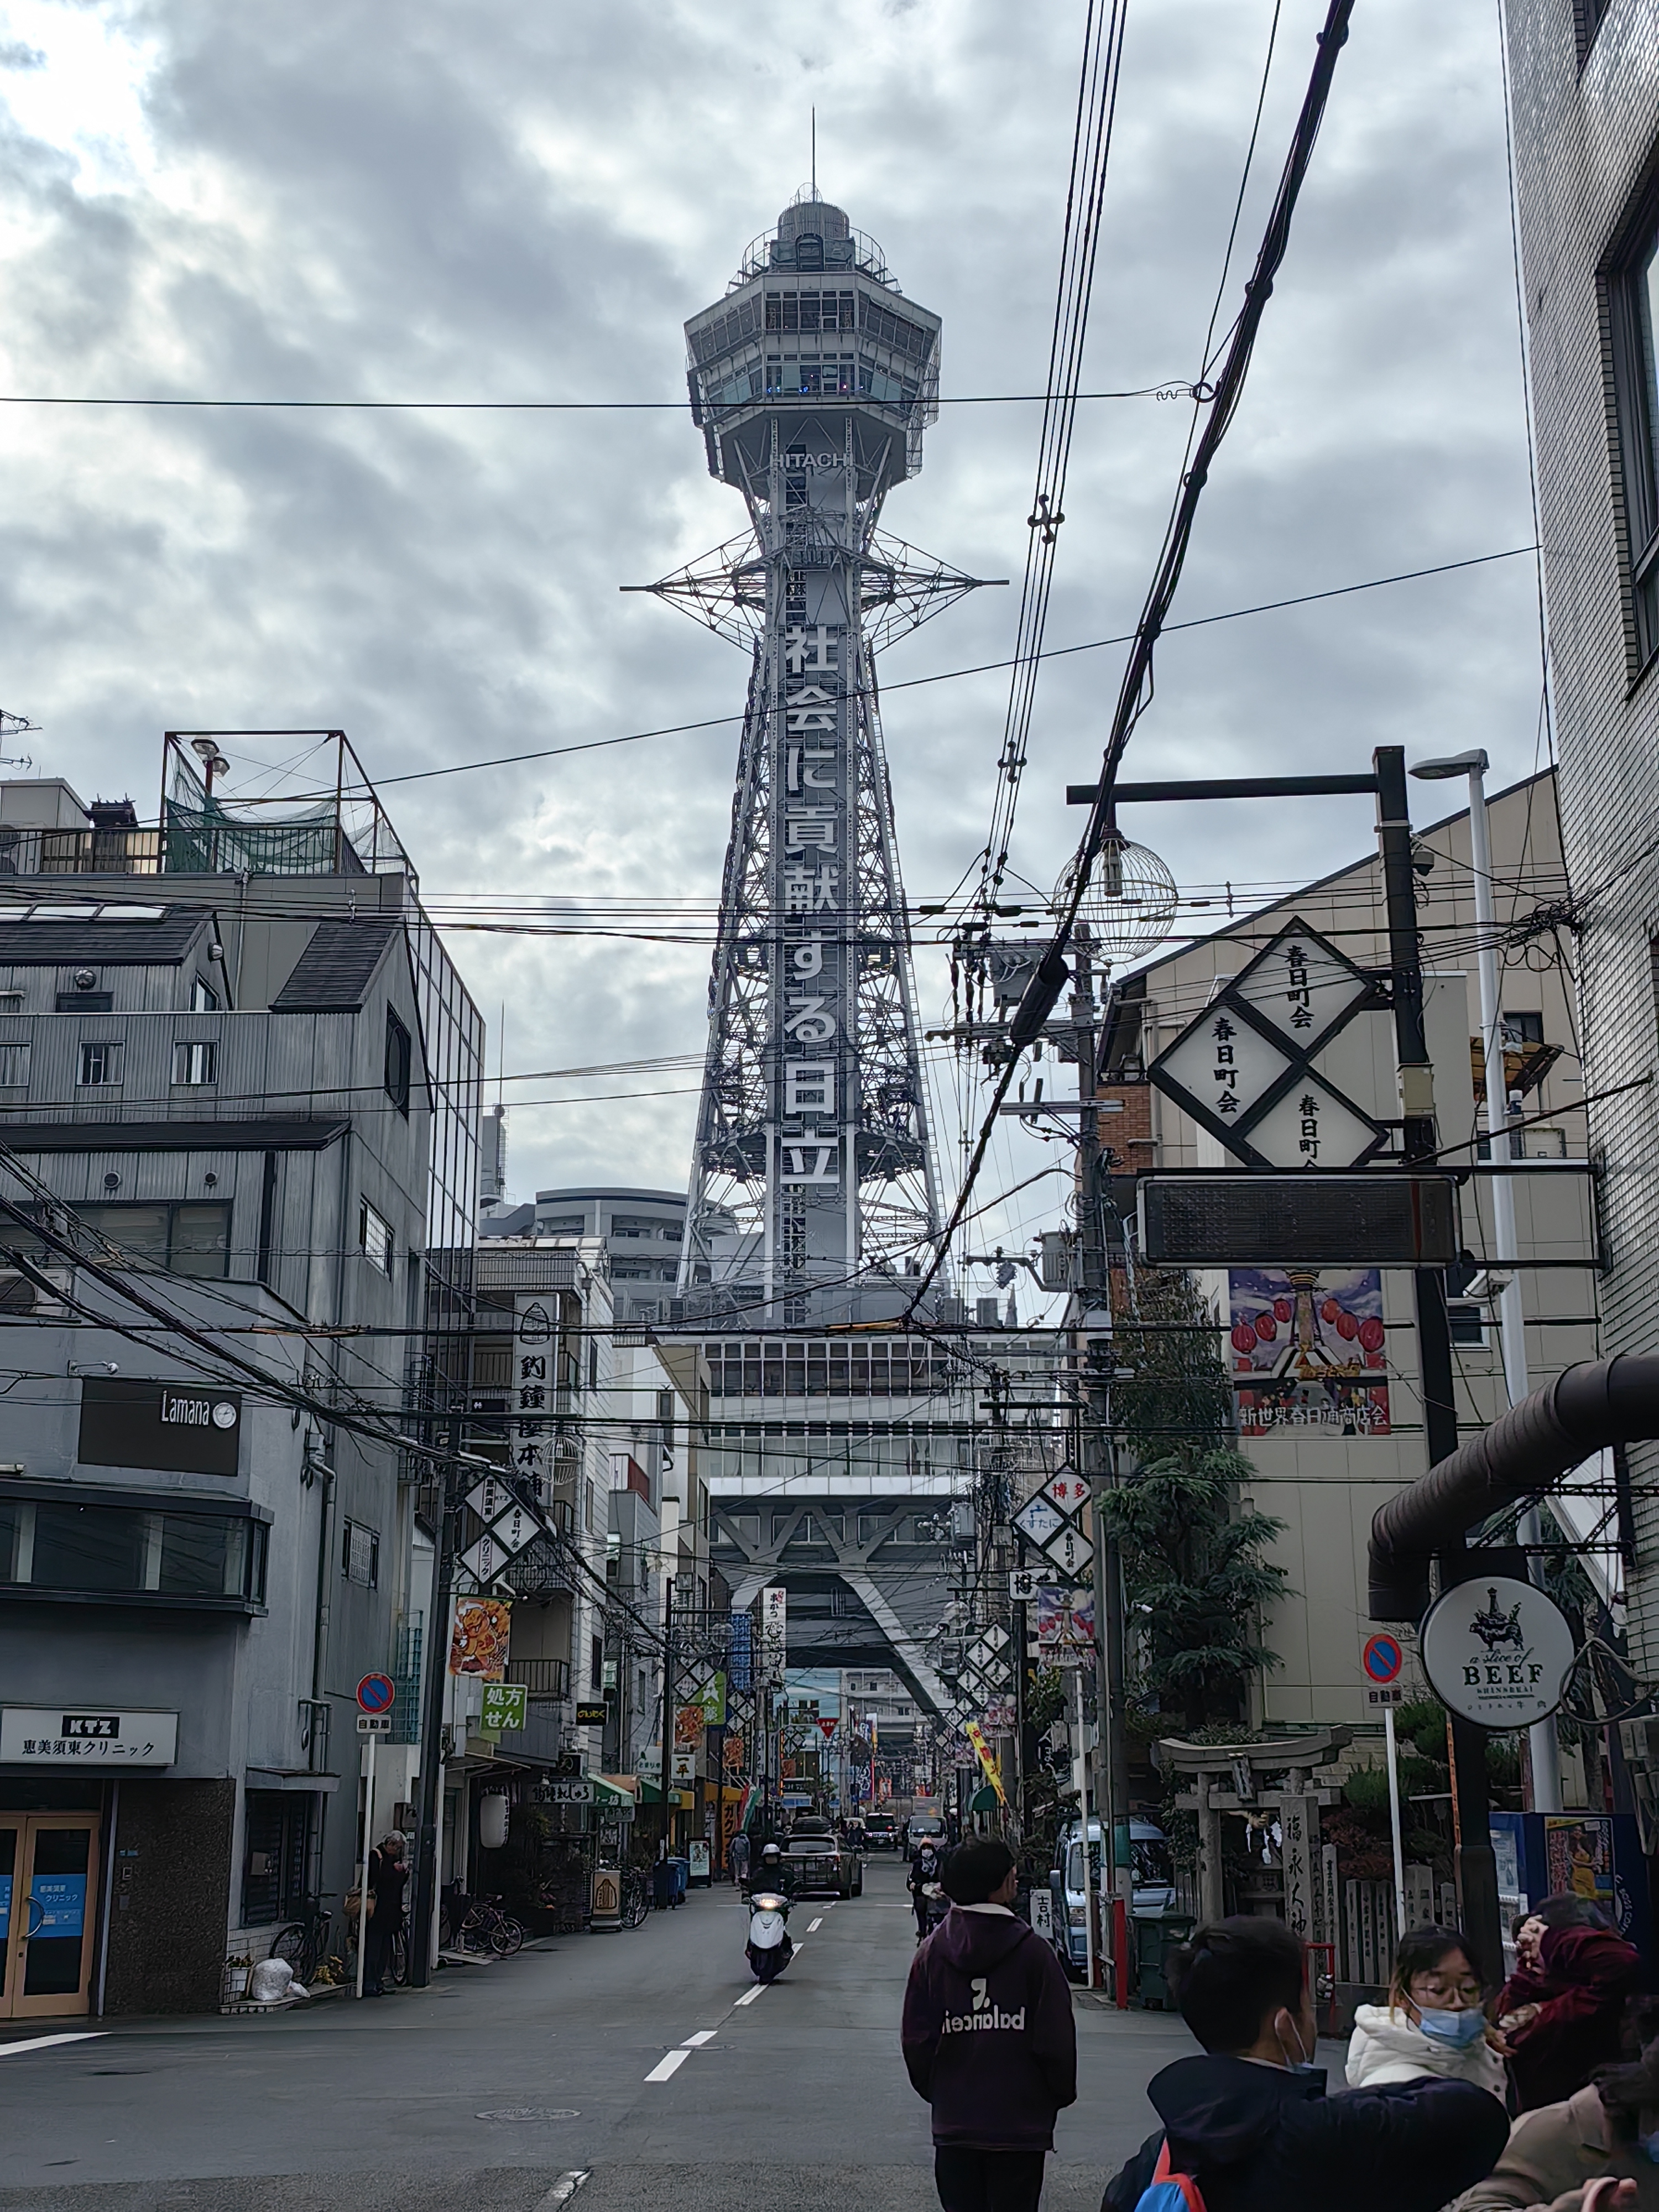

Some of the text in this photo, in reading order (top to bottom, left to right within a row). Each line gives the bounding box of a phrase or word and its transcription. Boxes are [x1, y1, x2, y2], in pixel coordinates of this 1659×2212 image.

[770, 453, 853, 468] HITACHI
[780, 625, 839, 1184] 社会に貢献する日立
[1285, 945, 1314, 1029] 春日町会
[1211, 1017, 1240, 1114] 春日町会
[161, 1390, 210, 1425] Lamana
[482, 1538, 491, 1575] クリニック
[1462, 1663, 1543, 1686] BEEF
[487, 1688, 523, 1707] 処方
[358, 1719, 390, 1729] 自動車
[485, 1711, 520, 1729] せん
[22, 1739, 154, 1757] 恵美須東クリニック
[676, 1757, 690, 1778] 一平
[45, 1894, 78, 1902] クリニック
[1037, 1896, 1050, 1928] 吉村
